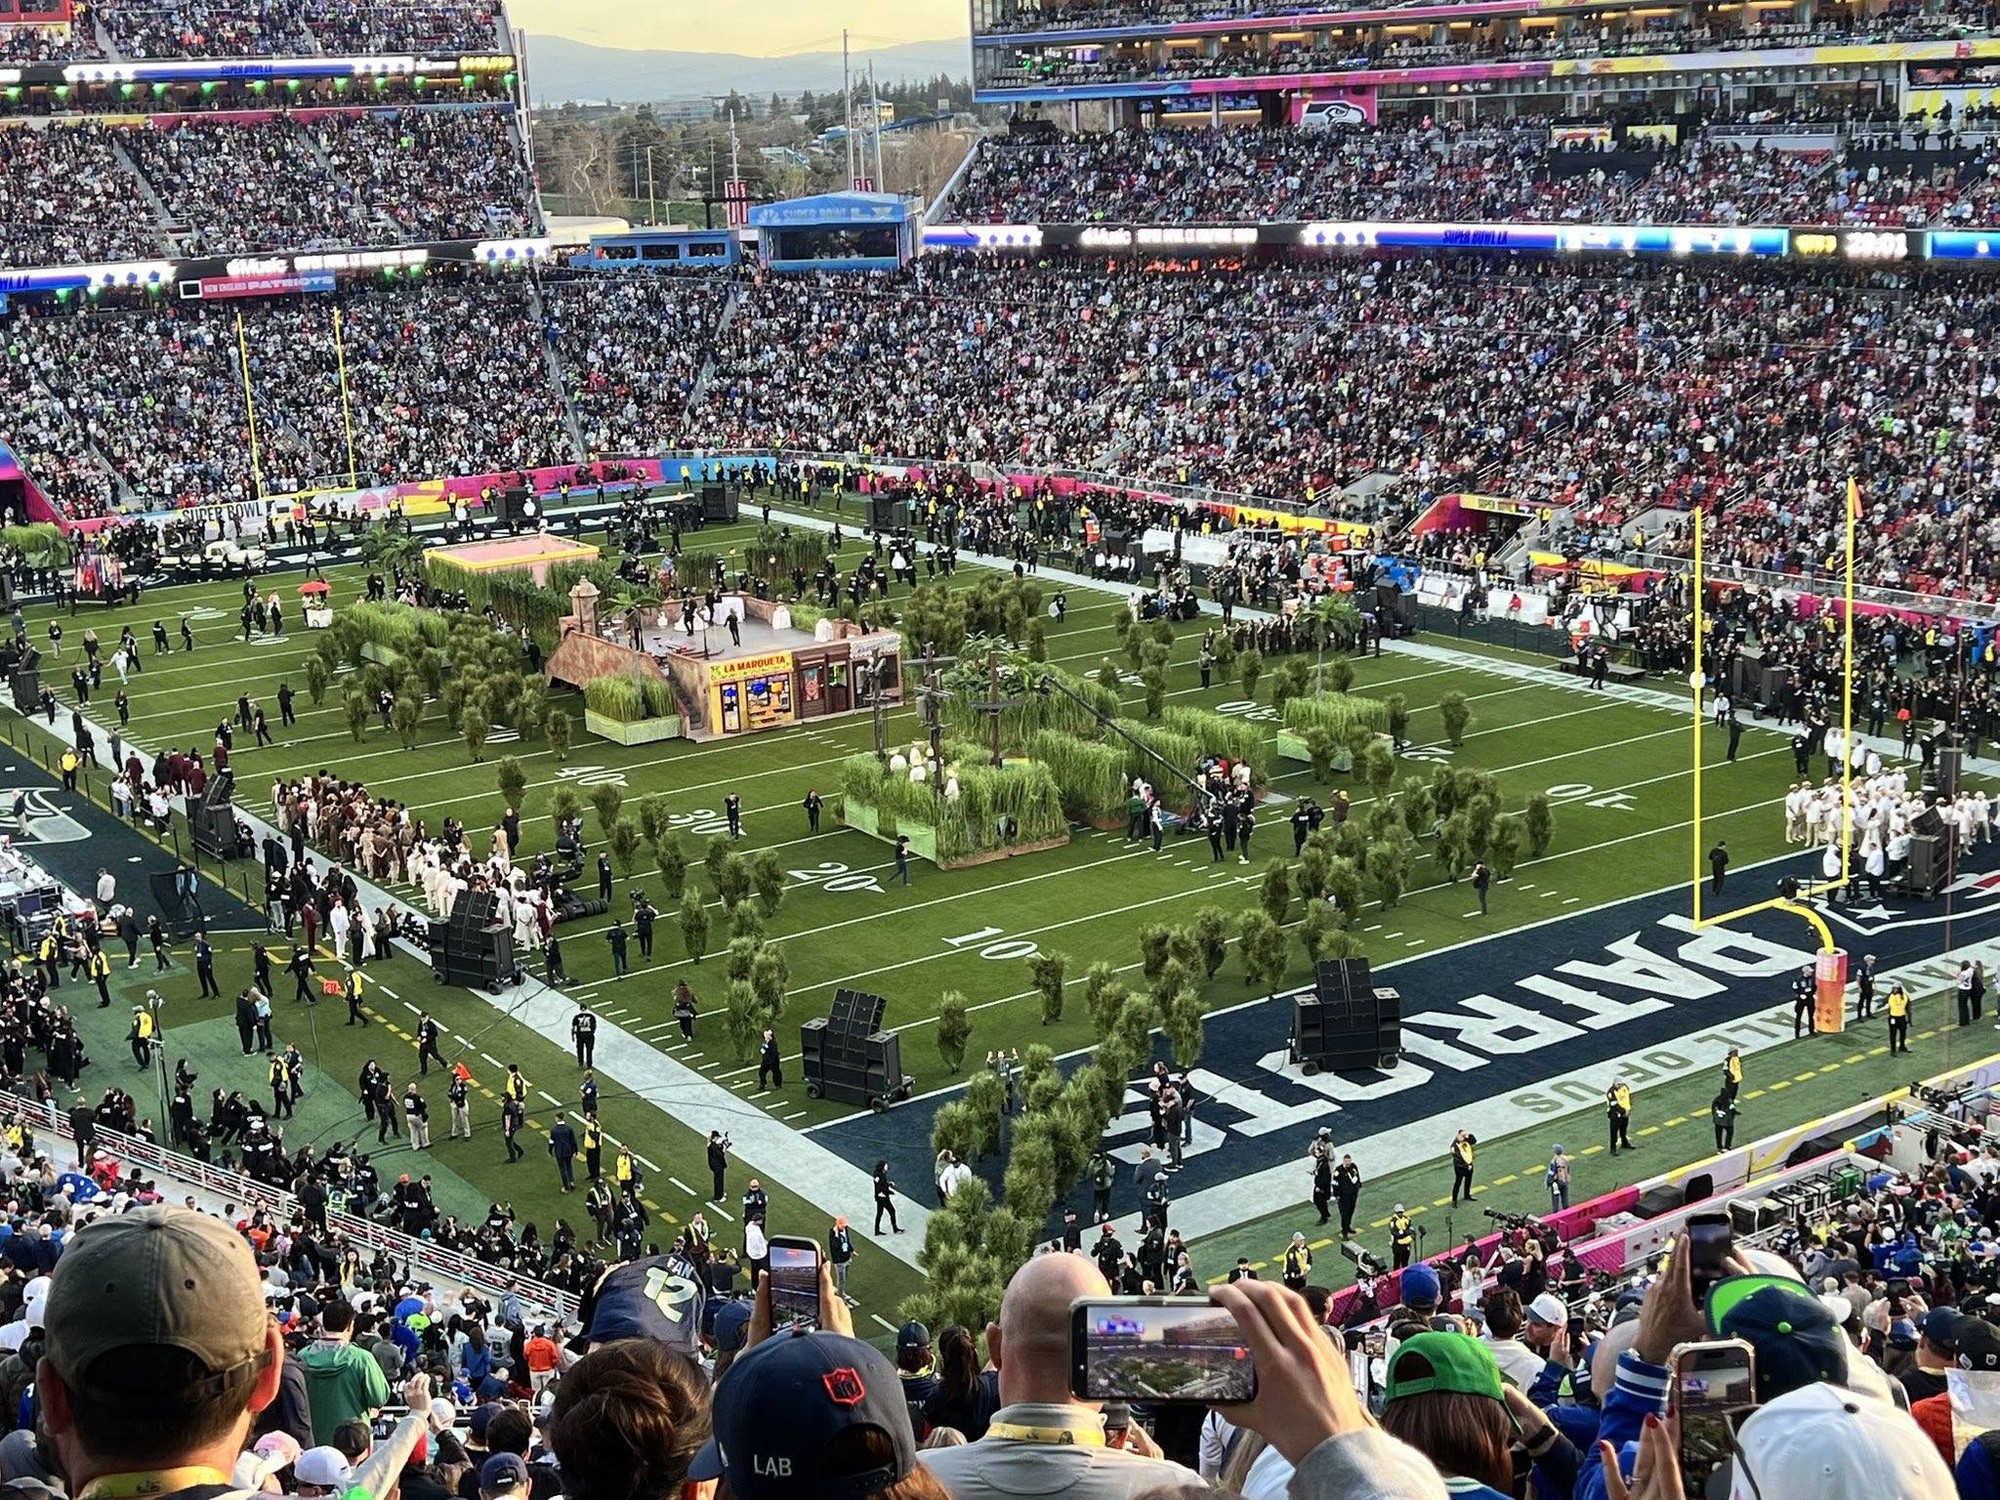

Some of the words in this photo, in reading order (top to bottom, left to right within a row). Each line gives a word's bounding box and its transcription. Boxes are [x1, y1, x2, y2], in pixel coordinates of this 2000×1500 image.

[782, 208, 818, 220] SUPER
[819, 207, 847, 219] BOWL
[1442, 229, 1470, 244] SUPER
[1471, 230, 1495, 244] BOWL
[248, 275, 335, 290] PATRIOTS
[182, 505, 224, 524] SUPER
[227, 500, 263, 520] BOWL
[724, 663, 735, 673] LA
[736, 655, 786, 671] MARQUETA
[555, 765, 627, 787] 40
[1545, 783, 1637, 809] 10
[668, 808, 734, 836] 30
[787, 861, 878, 893] 20
[941, 925, 1038, 960] 10
[1694, 1011, 1810, 1049] ALL
[1617, 1051, 1695, 1084] OF
[1510, 1081, 1606, 1114] US
[667, 1256, 695, 1279] FAN
[643, 1266, 698, 1323] 12
[753, 1453, 793, 1478] LAB
